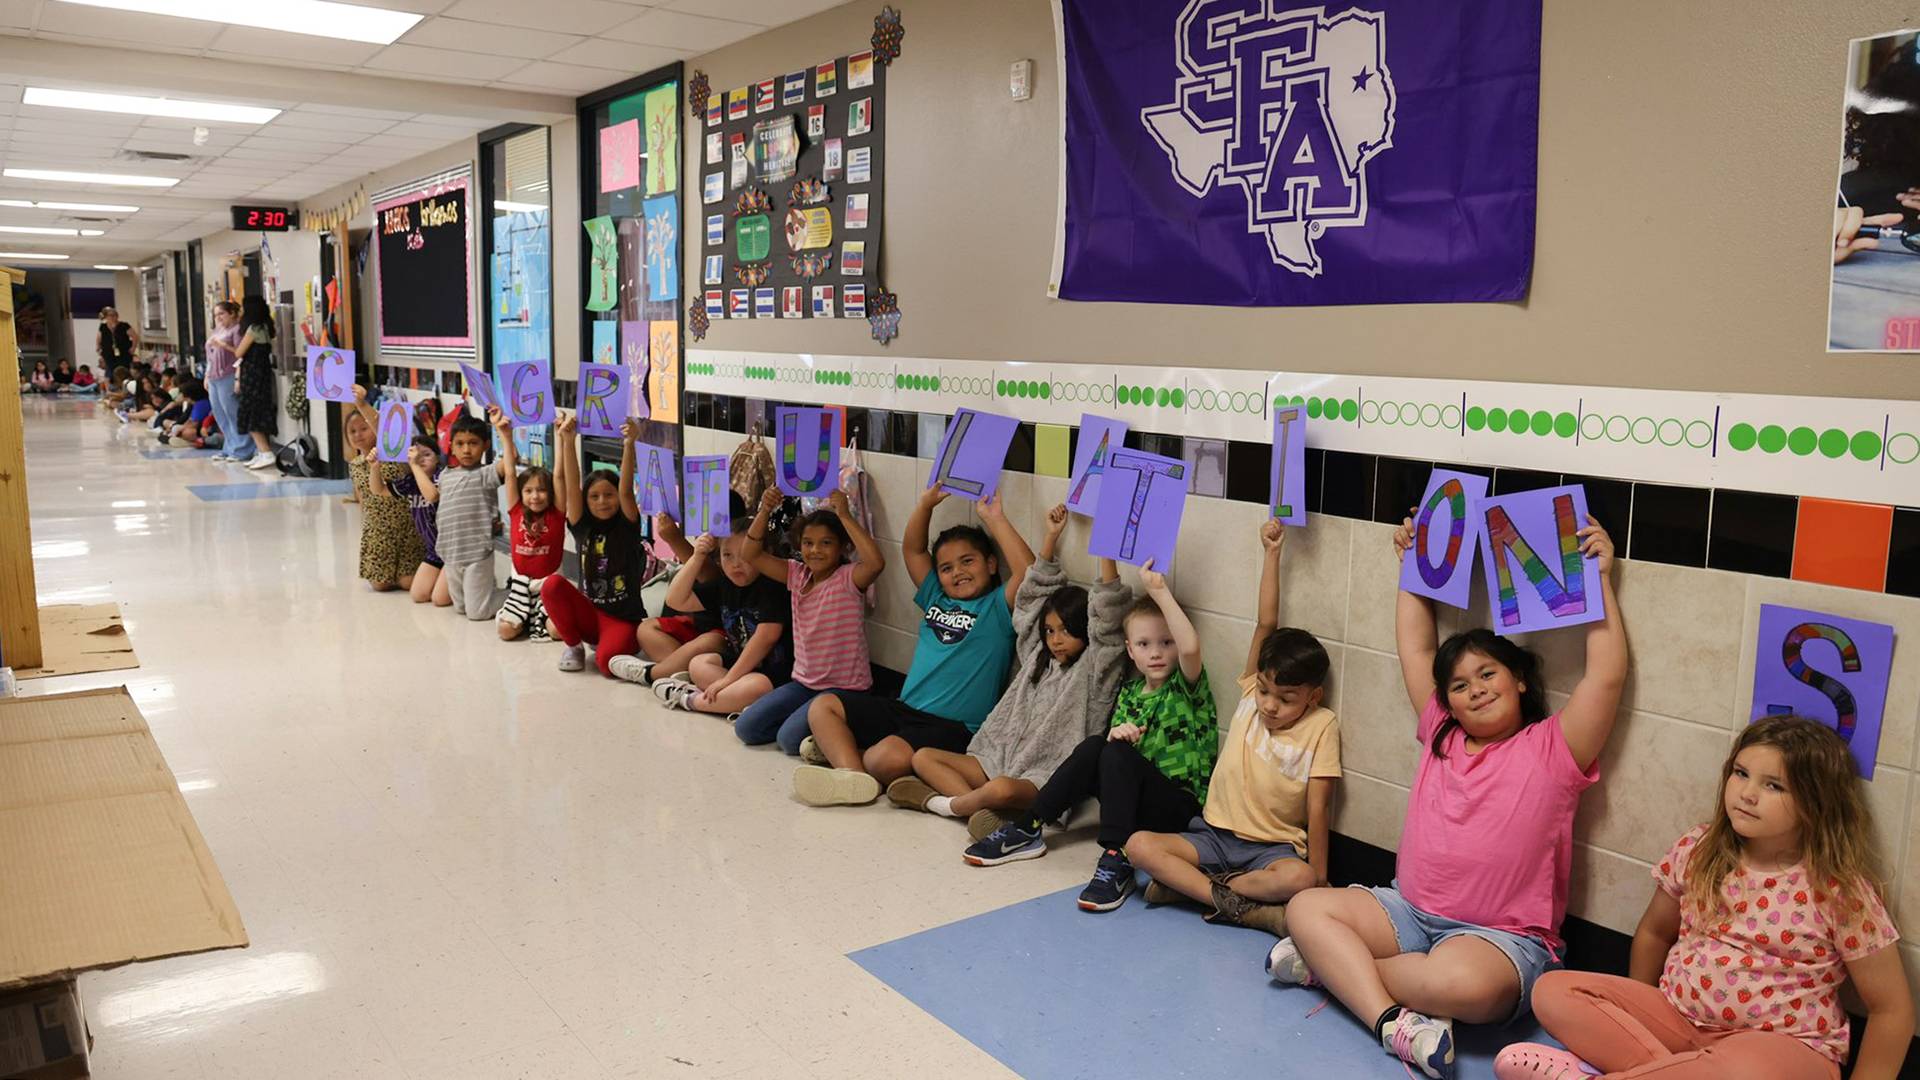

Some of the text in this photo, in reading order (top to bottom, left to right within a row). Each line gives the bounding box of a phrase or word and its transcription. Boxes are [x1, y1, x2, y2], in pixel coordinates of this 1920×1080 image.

[811, 117, 820, 133] 16
[1177, 0, 1362, 221] SFA
[313, 351, 344, 399] C
[382, 403, 408, 458] O
[511, 363, 544, 424] G
[581, 368, 620, 431] R
[643, 449, 670, 514] A
[687, 457, 726, 533] T
[782, 412, 833, 493] U
[936, 411, 984, 496] L
[1111, 452, 1185, 560] T
[1273, 409, 1298, 517] I
[1415, 477, 1466, 590] O
[1484, 493, 1588, 627] N
[1766, 622, 1862, 745] S
[925, 606, 977, 631] STRIKERS
